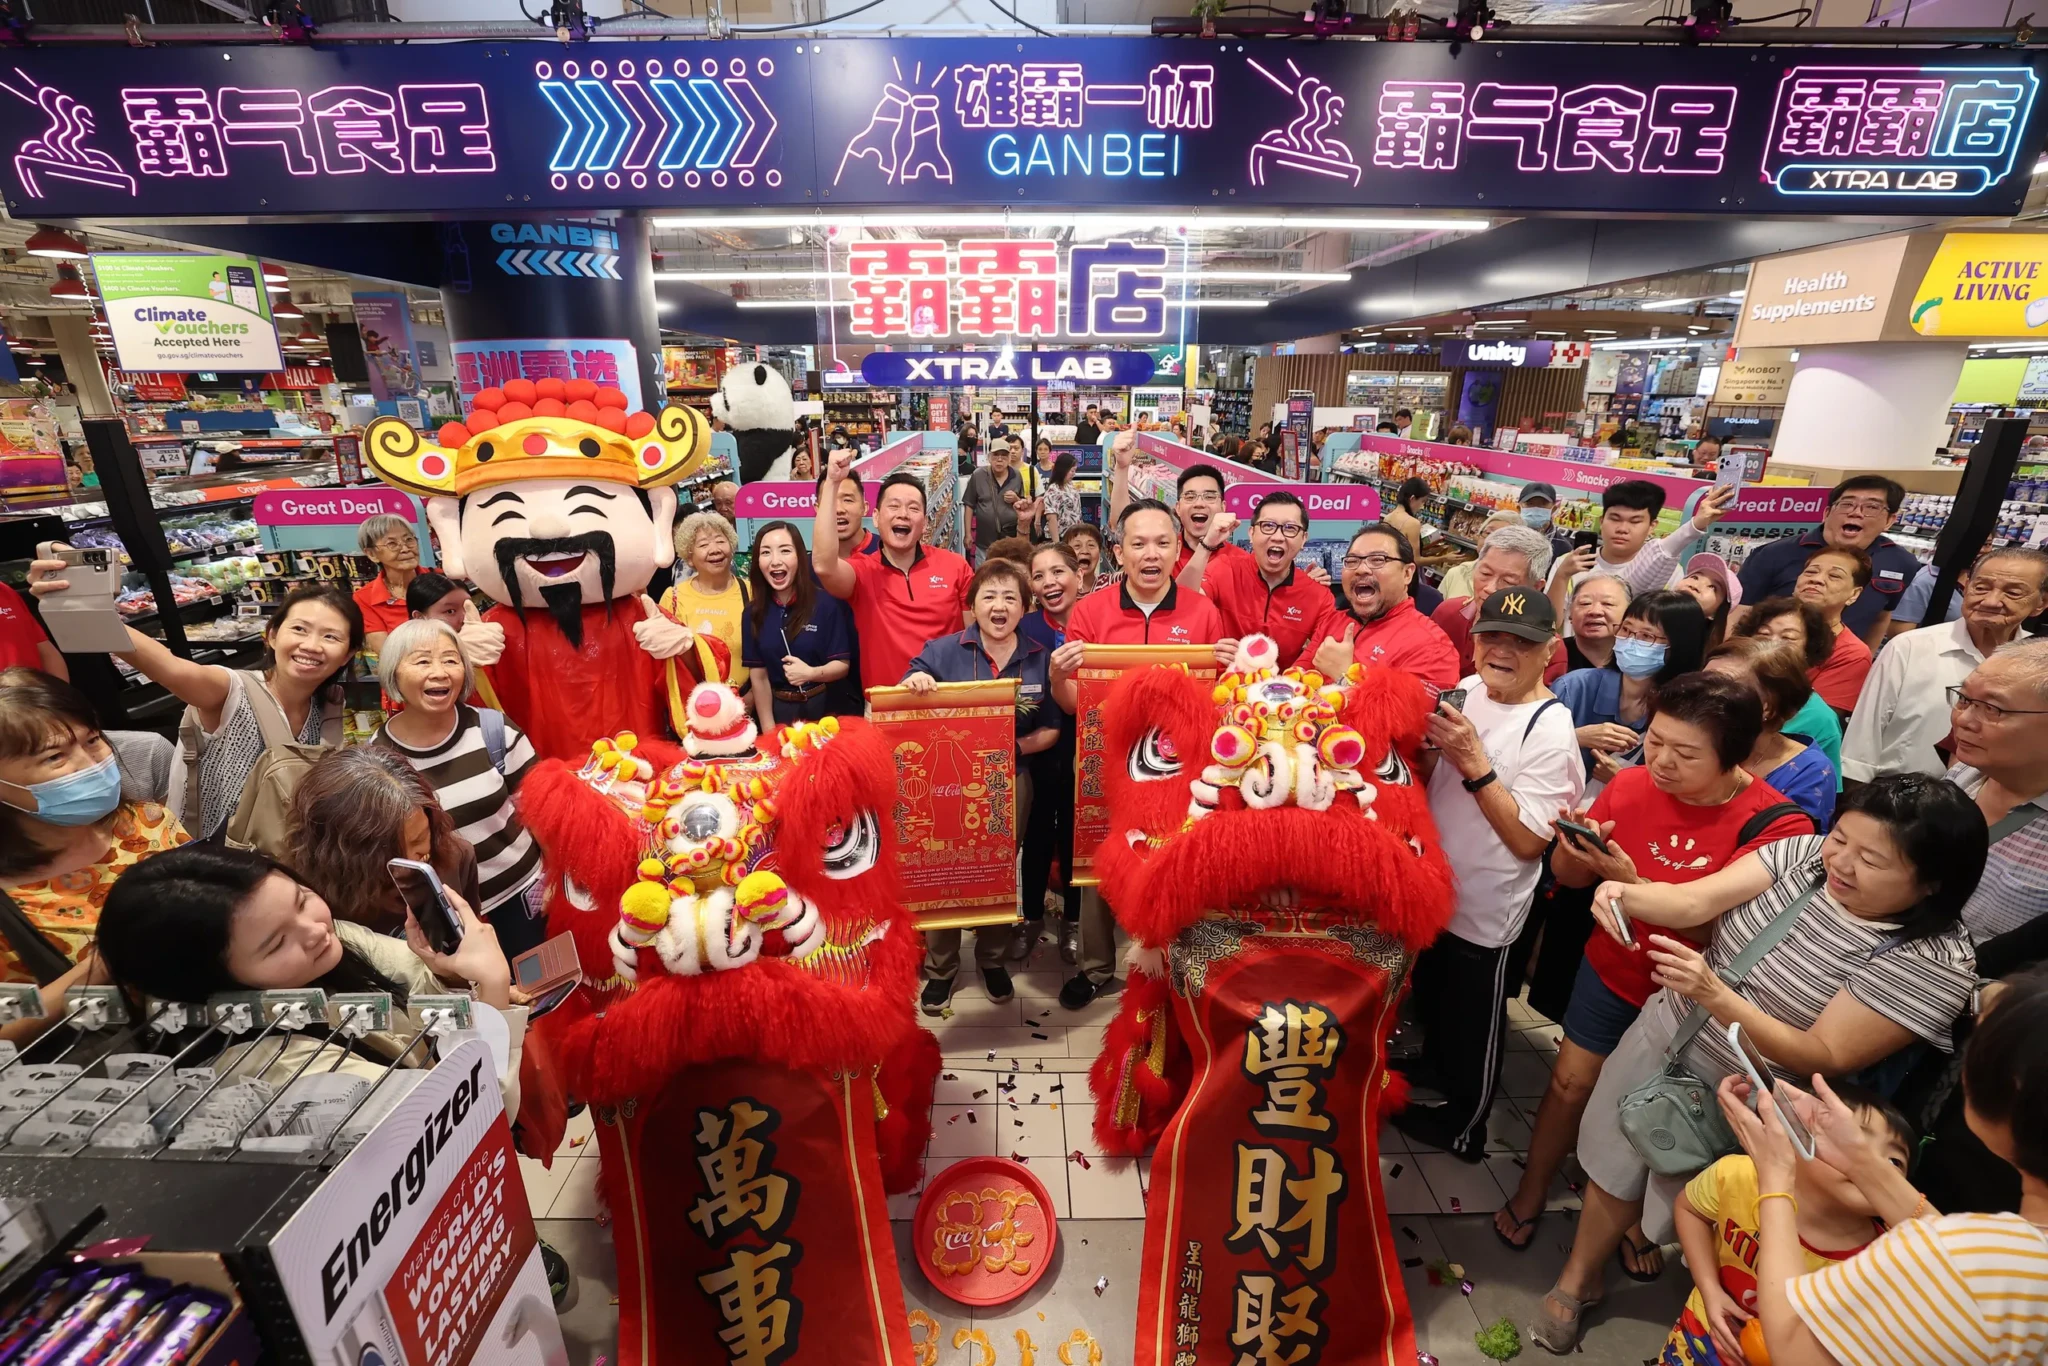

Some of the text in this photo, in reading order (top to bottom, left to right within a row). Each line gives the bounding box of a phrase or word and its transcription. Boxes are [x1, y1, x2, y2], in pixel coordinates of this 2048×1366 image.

[954, 63, 1214, 128] 雄霸一杯
[1373, 80, 1738, 174] 霸气食足
[1779, 78, 1984, 157] 霸霸店
[122, 83, 497, 177] 霸气食足
[986, 133, 1181, 177] GANBEI
[1809, 170, 1958, 189] XTRA LAB
[490, 223, 619, 250] GANBEI
[1957, 261, 2042, 279] ACTIVE
[847, 239, 1169, 338] 霸霸店
[1784, 270, 1848, 295] Health
[1953, 284, 2031, 301] LIVING
[134, 307, 207, 322] Climate
[1750, 294, 1876, 323] Supplements
[154, 337, 241, 349] Accepted Here
[904, 357, 1112, 380] XTRA LAB
[1406, 445, 1423, 455] Snacks
[237, 484, 269, 495] Organic
[1576, 471, 1609, 487] Snacks
[281, 499, 384, 515] Great Deal
[762, 492, 817, 508] Great
[1309, 495, 1351, 511] Deal
[1733, 498, 1822, 512] reat Deal
[1171, 625, 1188, 636] Xtra
[985, 750, 1010, 837] 心想事成
[1647, 842, 1660, 855] The
[1654, 855, 1685, 870] joy of
[321, 1056, 483, 1327] Energizer
[403, 1150, 489, 1290] Makers of the
[408, 1147, 506, 1310] WORLD'S
[689, 1101, 792, 1366] 萬事
[417, 1178, 505, 1338] LONGEST
[425, 1213, 505, 1362] LASTING
